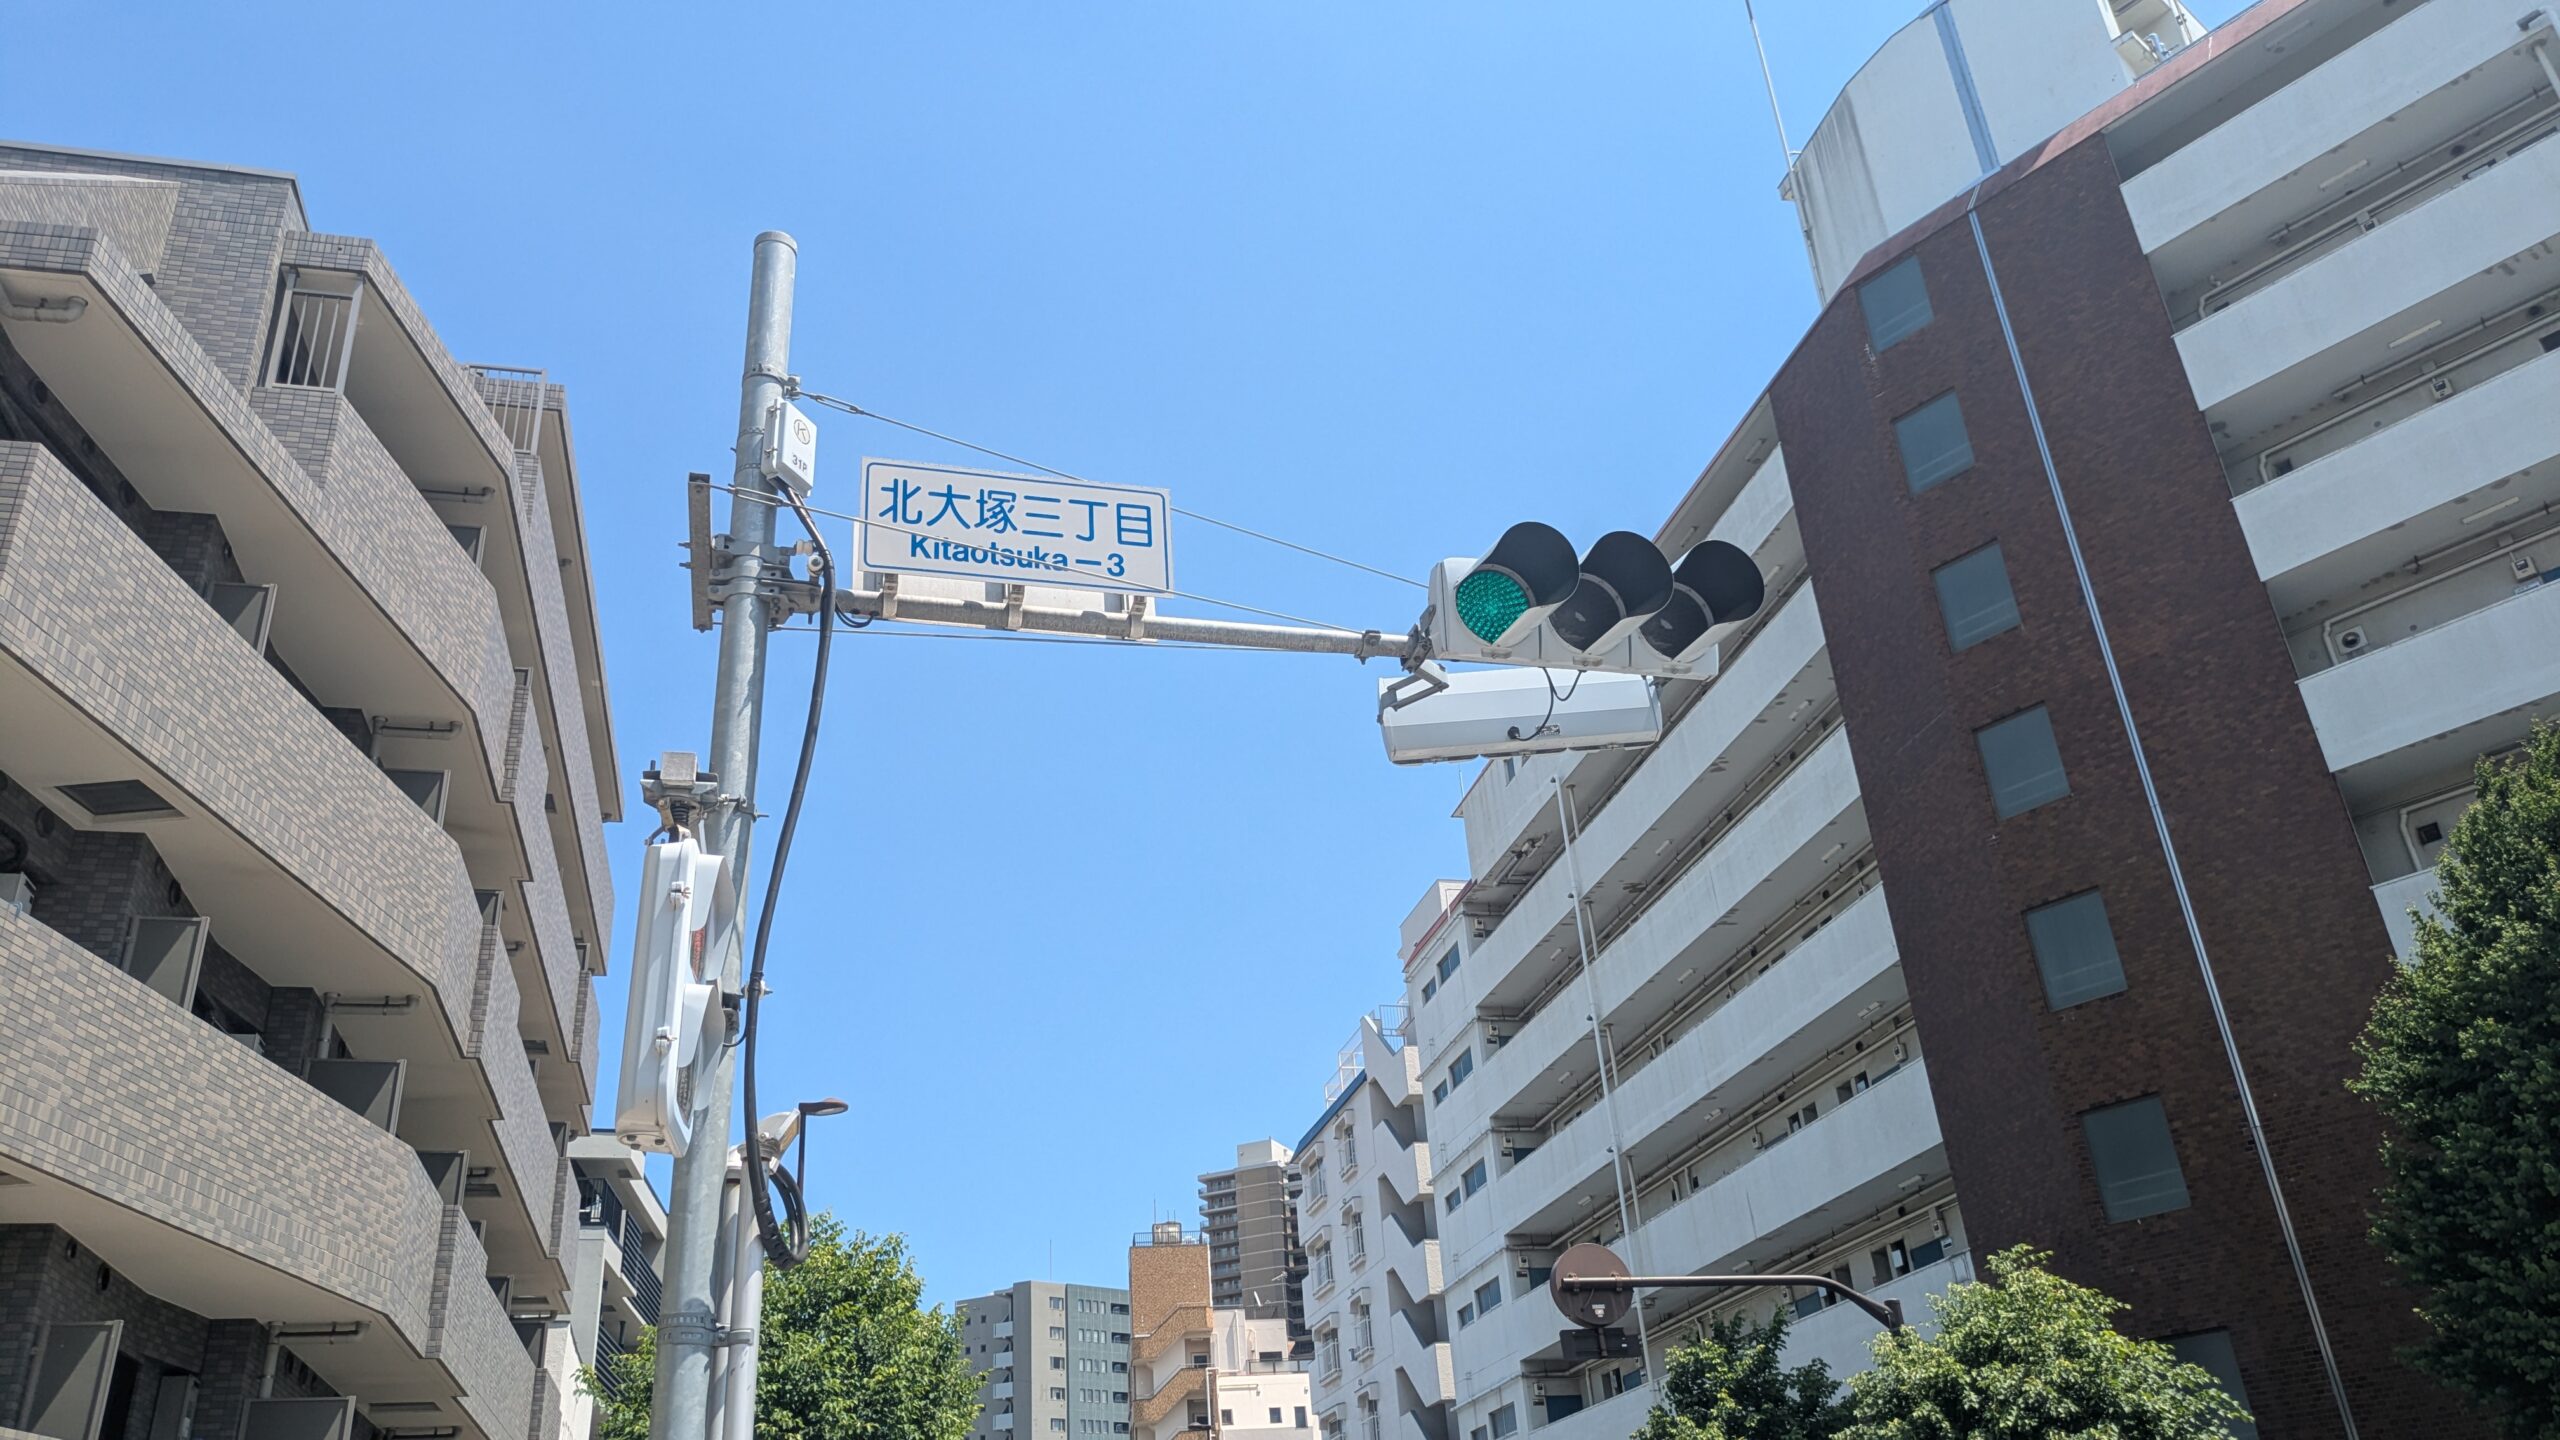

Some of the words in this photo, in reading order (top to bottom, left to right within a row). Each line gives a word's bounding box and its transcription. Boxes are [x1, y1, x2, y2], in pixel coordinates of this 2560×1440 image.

[879, 479, 1152, 547] 北大塚三丁目
